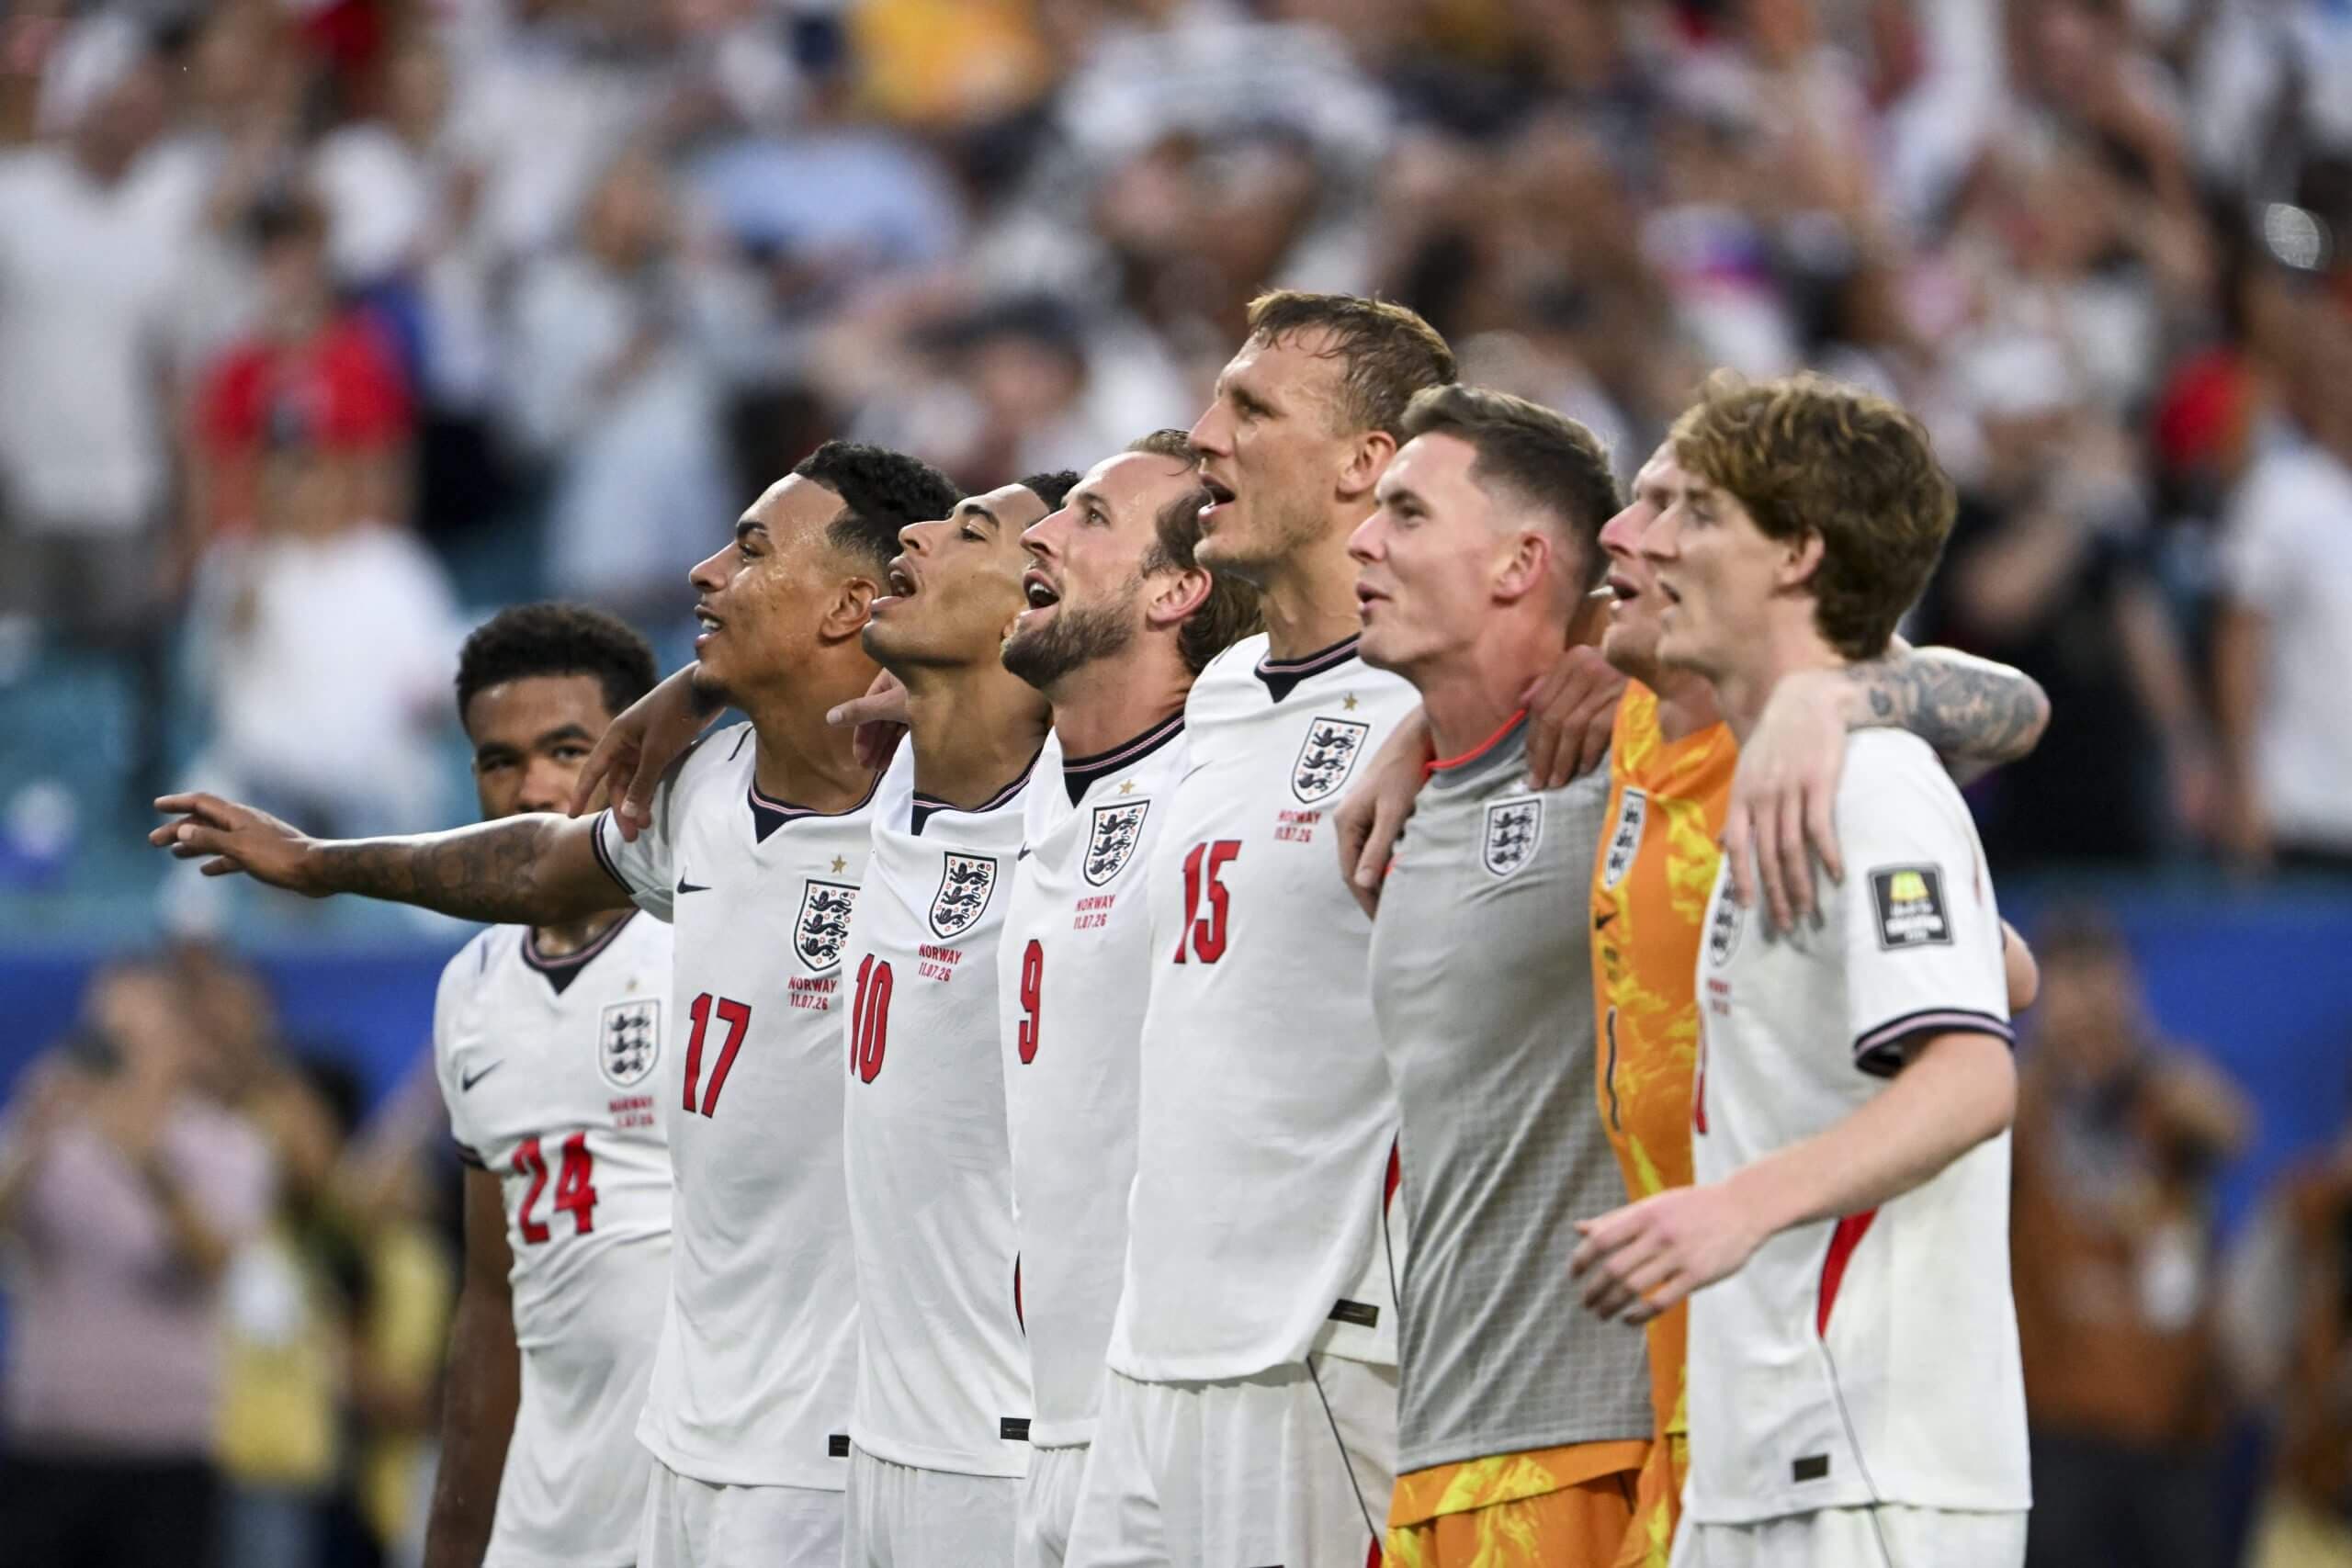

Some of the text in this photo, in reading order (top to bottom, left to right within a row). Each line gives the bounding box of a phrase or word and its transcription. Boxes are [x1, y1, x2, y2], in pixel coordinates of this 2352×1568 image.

[1076, 894, 1116, 911] NORWAY
[1173, 840, 1242, 964] 15
[787, 976, 837, 994] NORWAY
[918, 962, 952, 982] 11.07.26
[919, 943, 962, 965] NORWAY
[790, 993, 828, 1010] 11.07.26
[850, 953, 893, 1084] 10
[1018, 939, 1044, 1065] 9
[683, 992, 752, 1119] 17
[512, 1131, 597, 1245] 24
